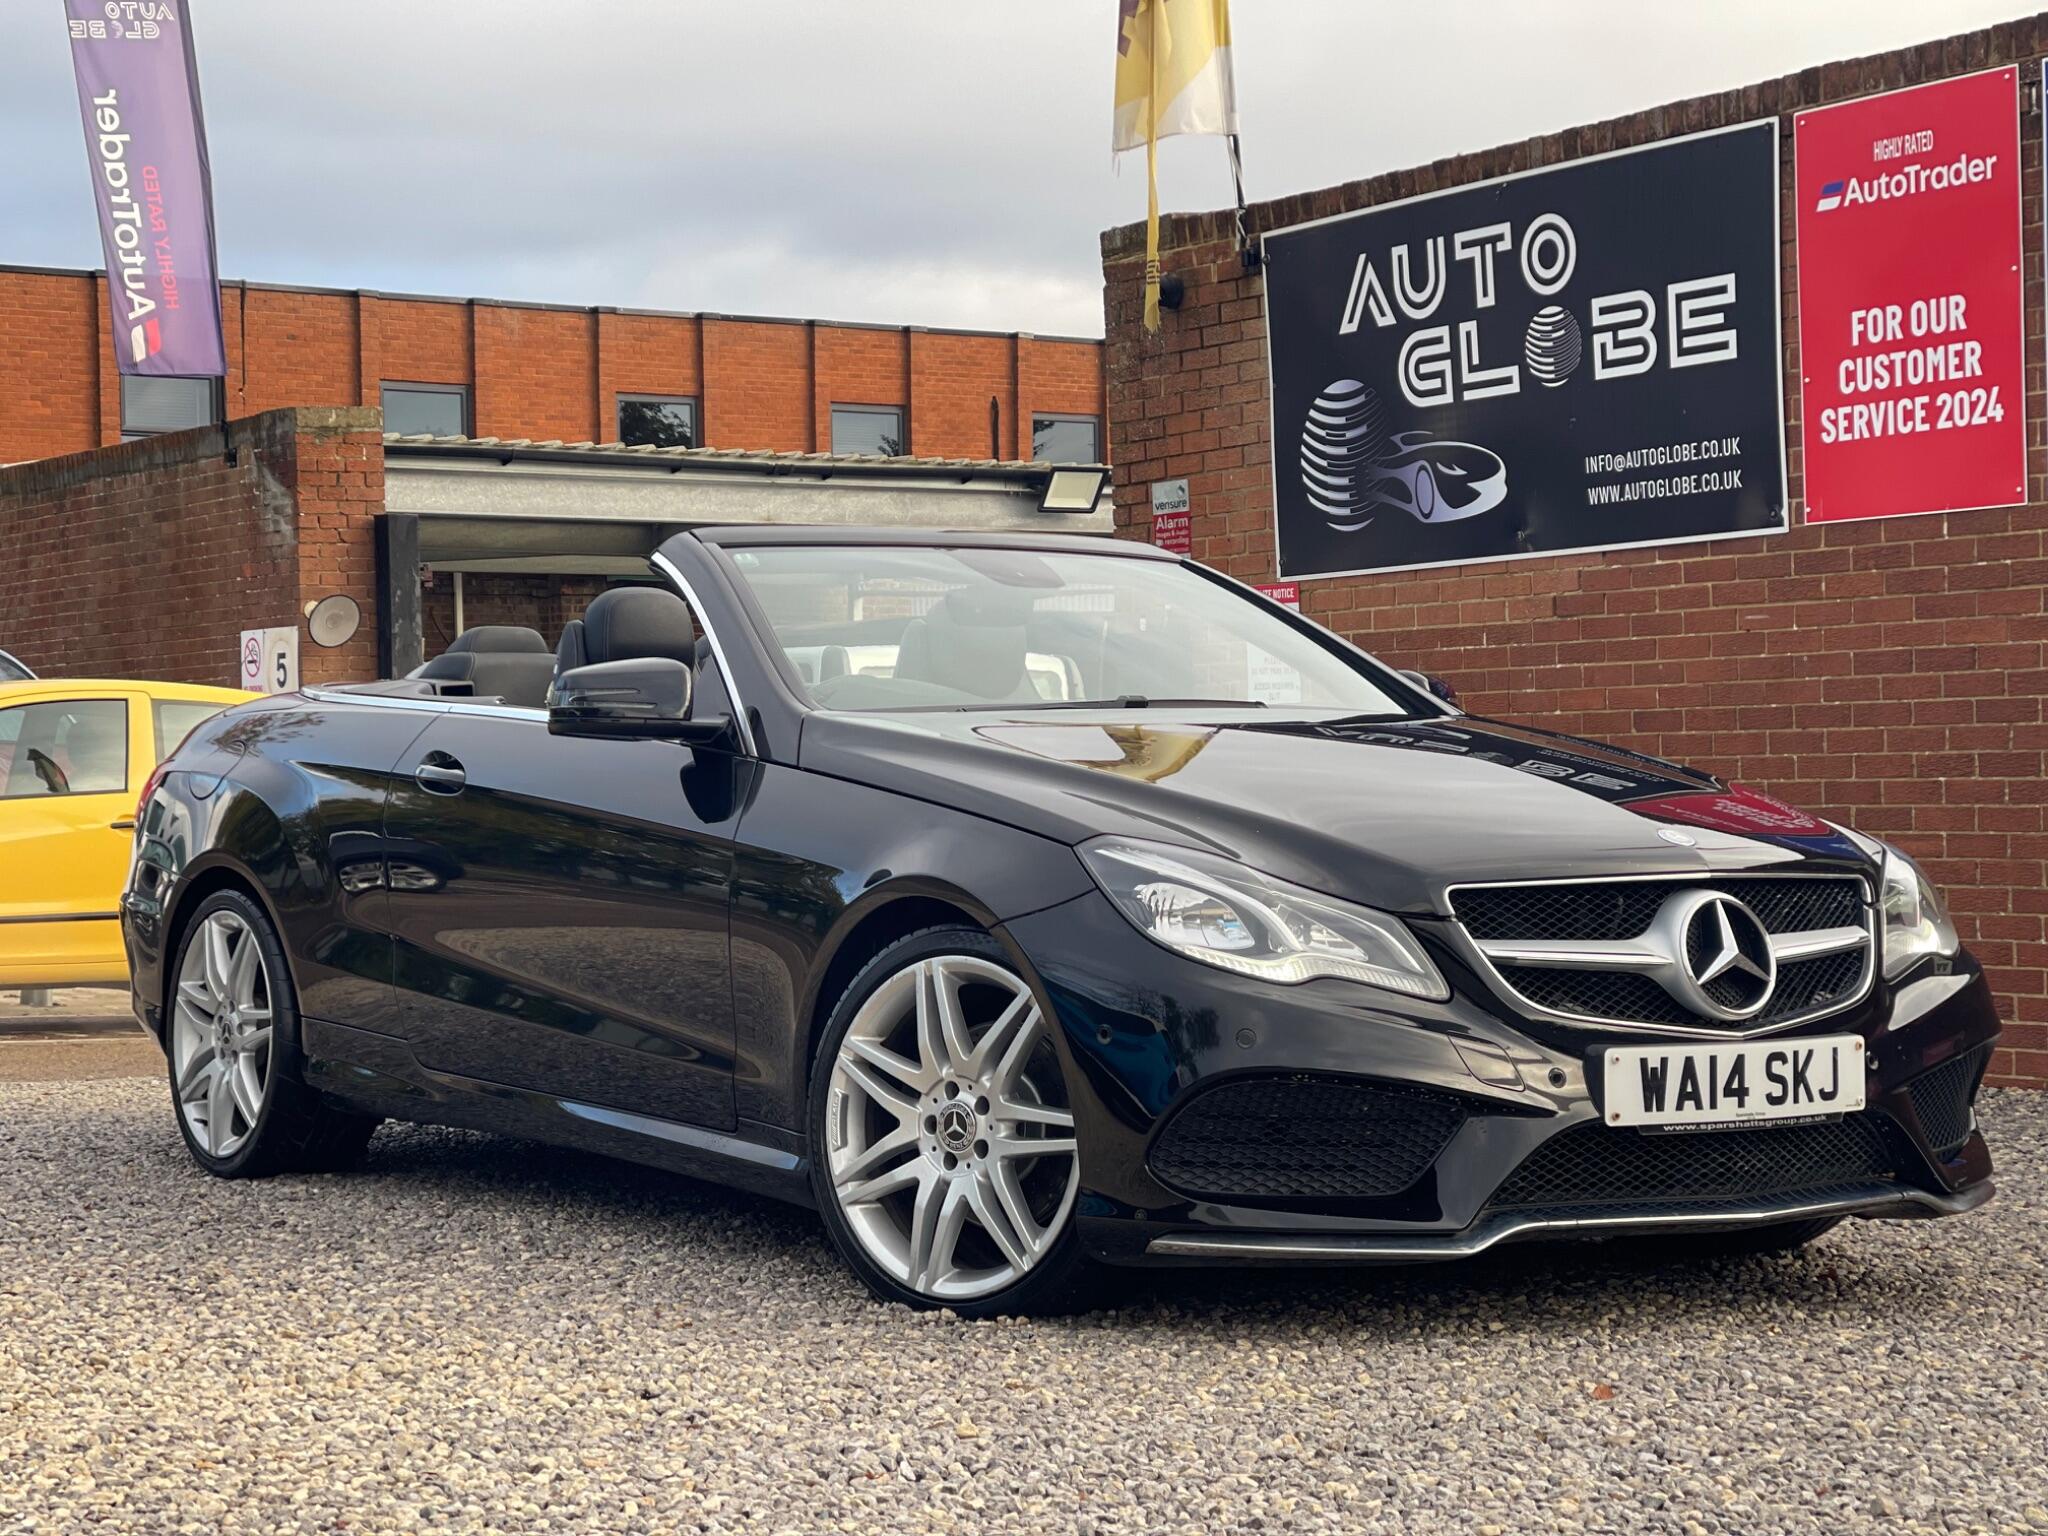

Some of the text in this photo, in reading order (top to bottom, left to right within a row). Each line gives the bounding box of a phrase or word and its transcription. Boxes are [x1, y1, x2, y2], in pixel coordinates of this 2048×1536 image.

[1873, 129, 1934, 162] HIGHLY RATED
[1843, 153, 1997, 207] AutoTrader
[1339, 212, 1577, 334] AUTO
[1398, 273, 1738, 408] GLOBE
[1851, 294, 1967, 347] FOR OUR
[1838, 340, 1983, 395] CUSTOMER
[1820, 385, 2004, 444] SERVICE 2024
[1585, 437, 1741, 474] INFO@AUTOGLOBE.CO.UK
[1587, 470, 1743, 505] WWW.AUTOGLOBE.CO.UK
[1156, 515, 1189, 530] Alarm
[1273, 587, 1295, 599] NOTICE
[277, 653, 287, 688] 5
[1639, 1046, 1839, 1113] WA14 SKJ
[1662, 1113, 1828, 1132] www.sparshattsgroup.co.uk
